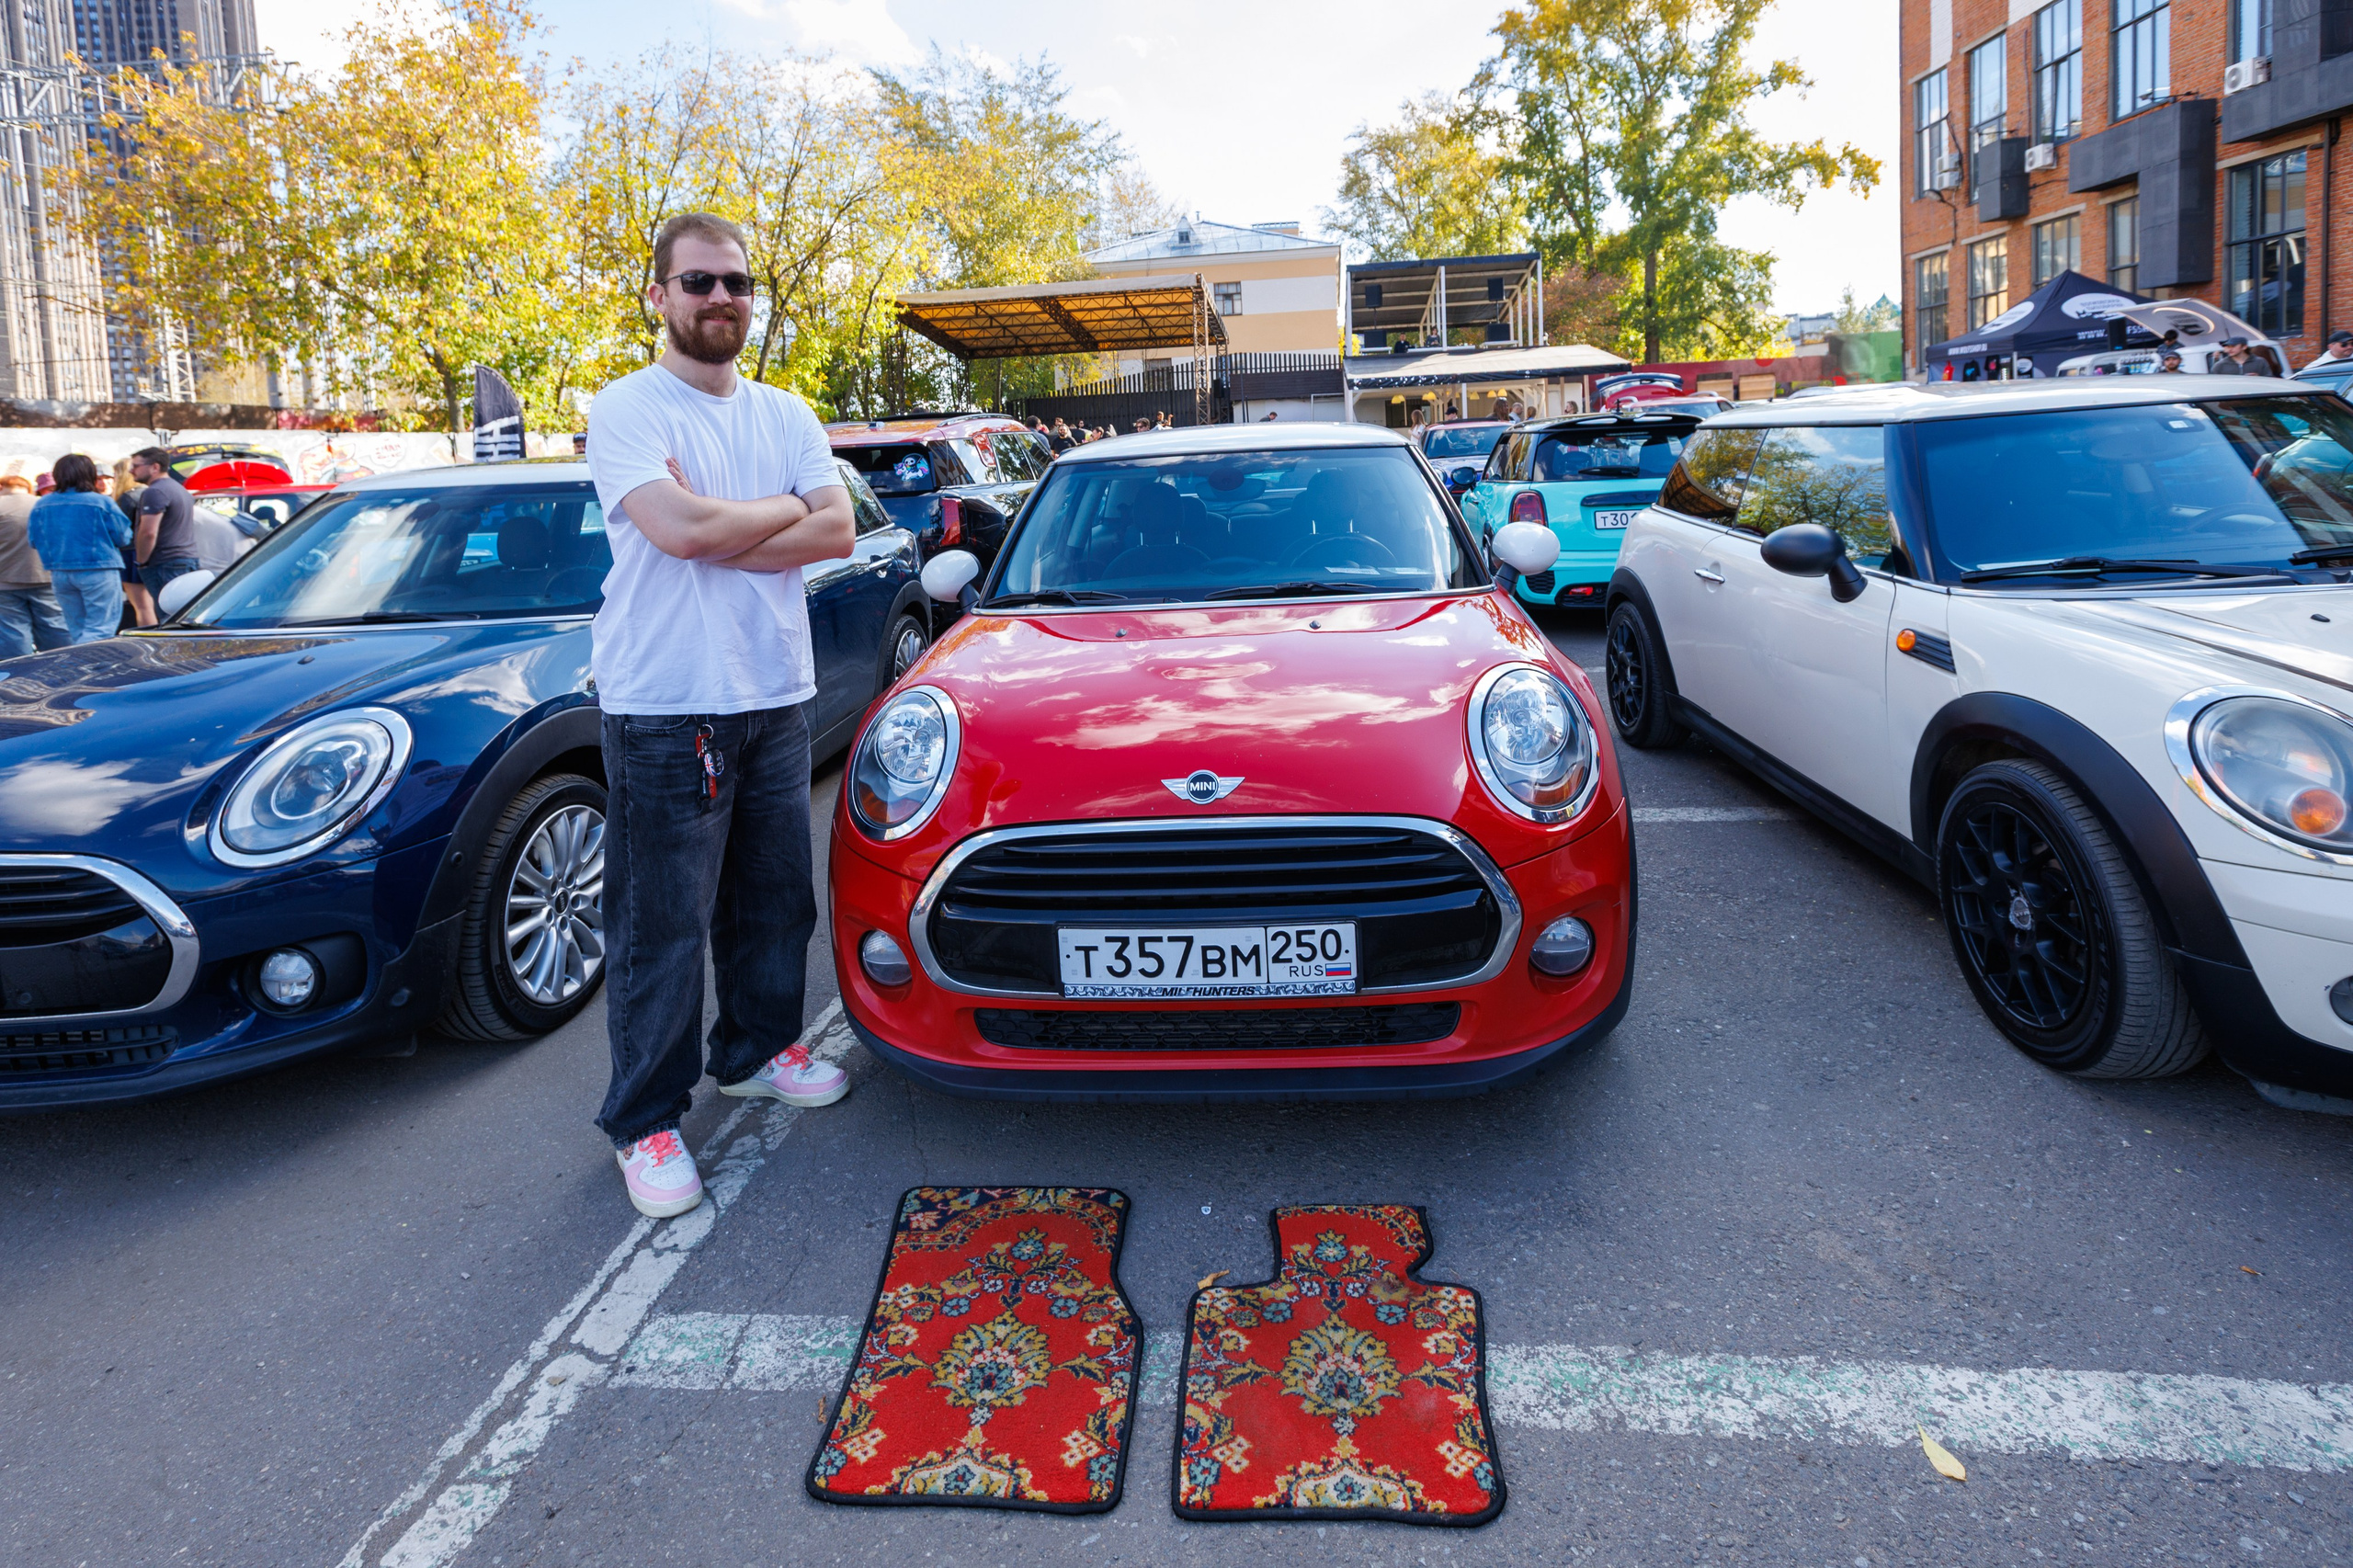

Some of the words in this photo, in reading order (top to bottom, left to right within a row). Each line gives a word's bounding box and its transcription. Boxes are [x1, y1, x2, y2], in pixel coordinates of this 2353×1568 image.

[1600, 512, 1637, 527] T30
[1189, 781, 1216, 791] MINI
[1074, 935, 1262, 979] T357BM
[1270, 928, 1342, 964] 250
[1289, 965, 1324, 978] RUS
